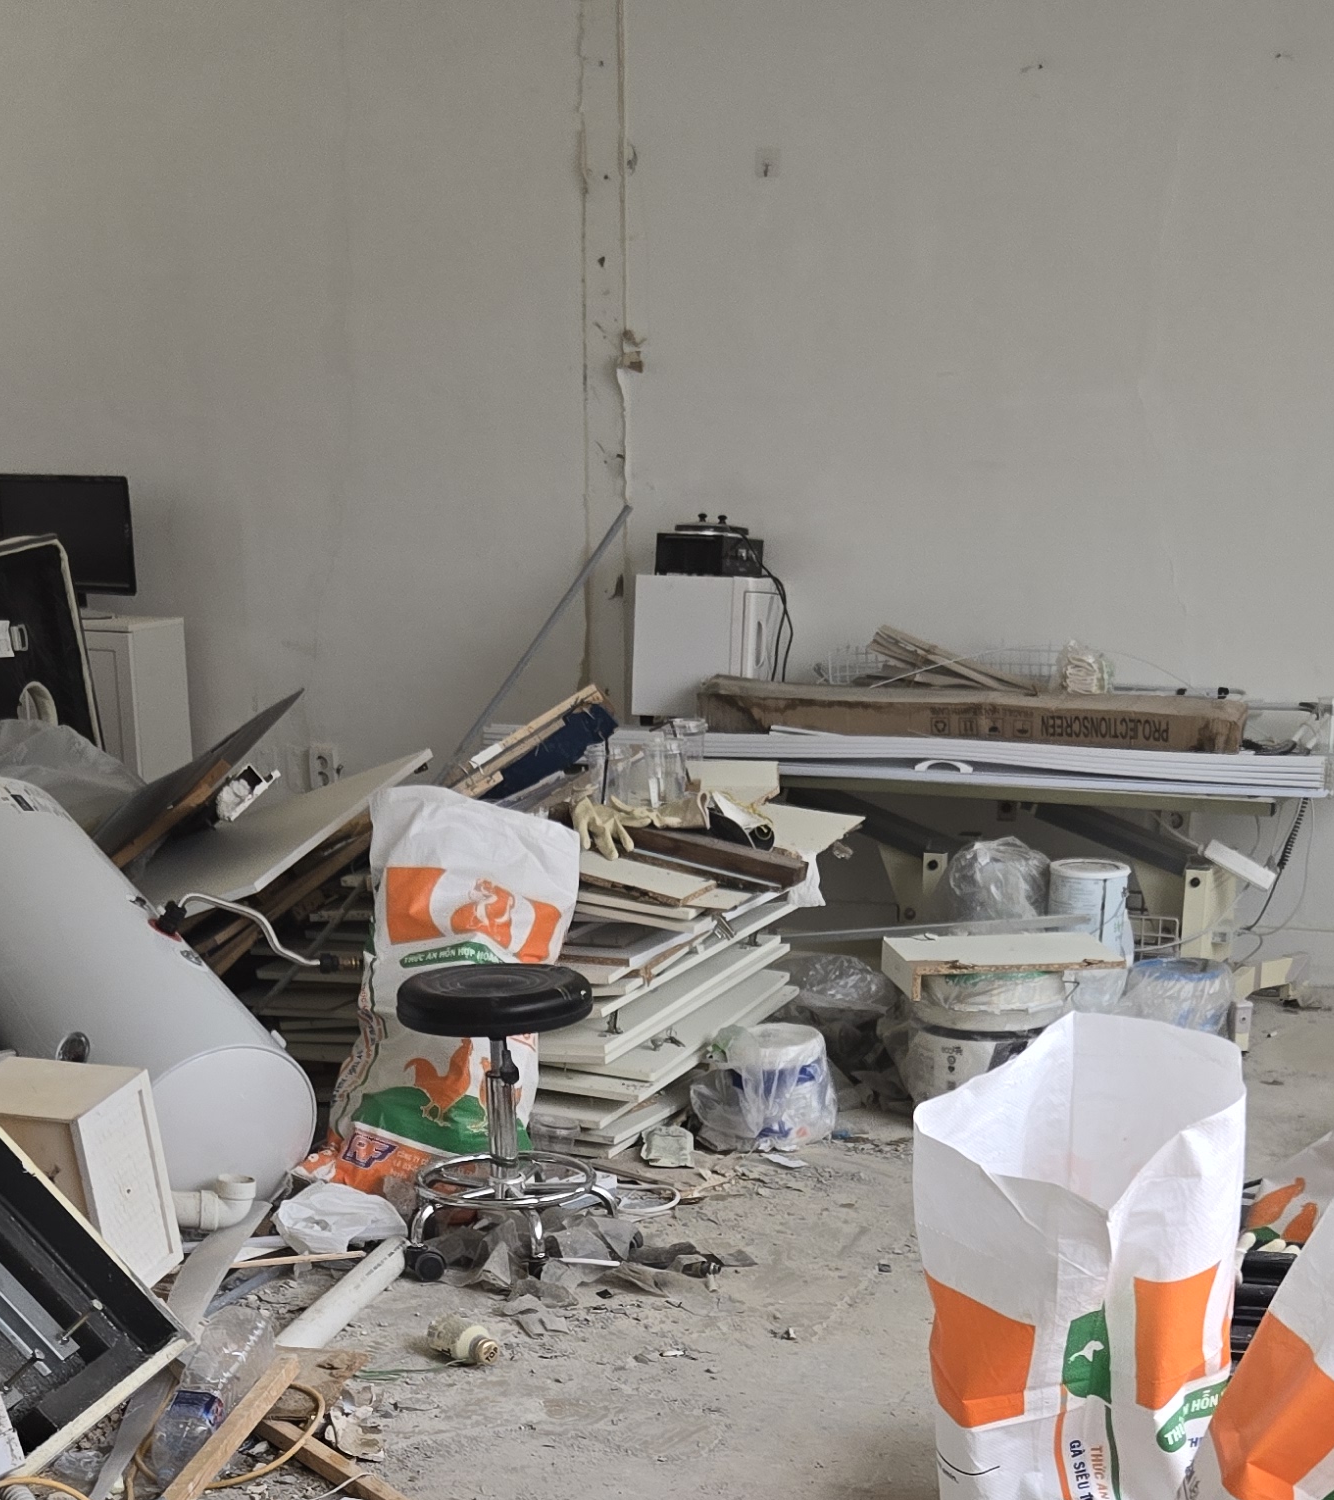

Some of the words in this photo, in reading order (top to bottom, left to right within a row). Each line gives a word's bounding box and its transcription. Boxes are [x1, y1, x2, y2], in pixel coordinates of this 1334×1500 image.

[1042, 713, 1169, 742] PROJECTIONSCREEN
[1068, 1439, 1085, 1457] GÀ
[1073, 1461, 1090, 1489] SIÊU
